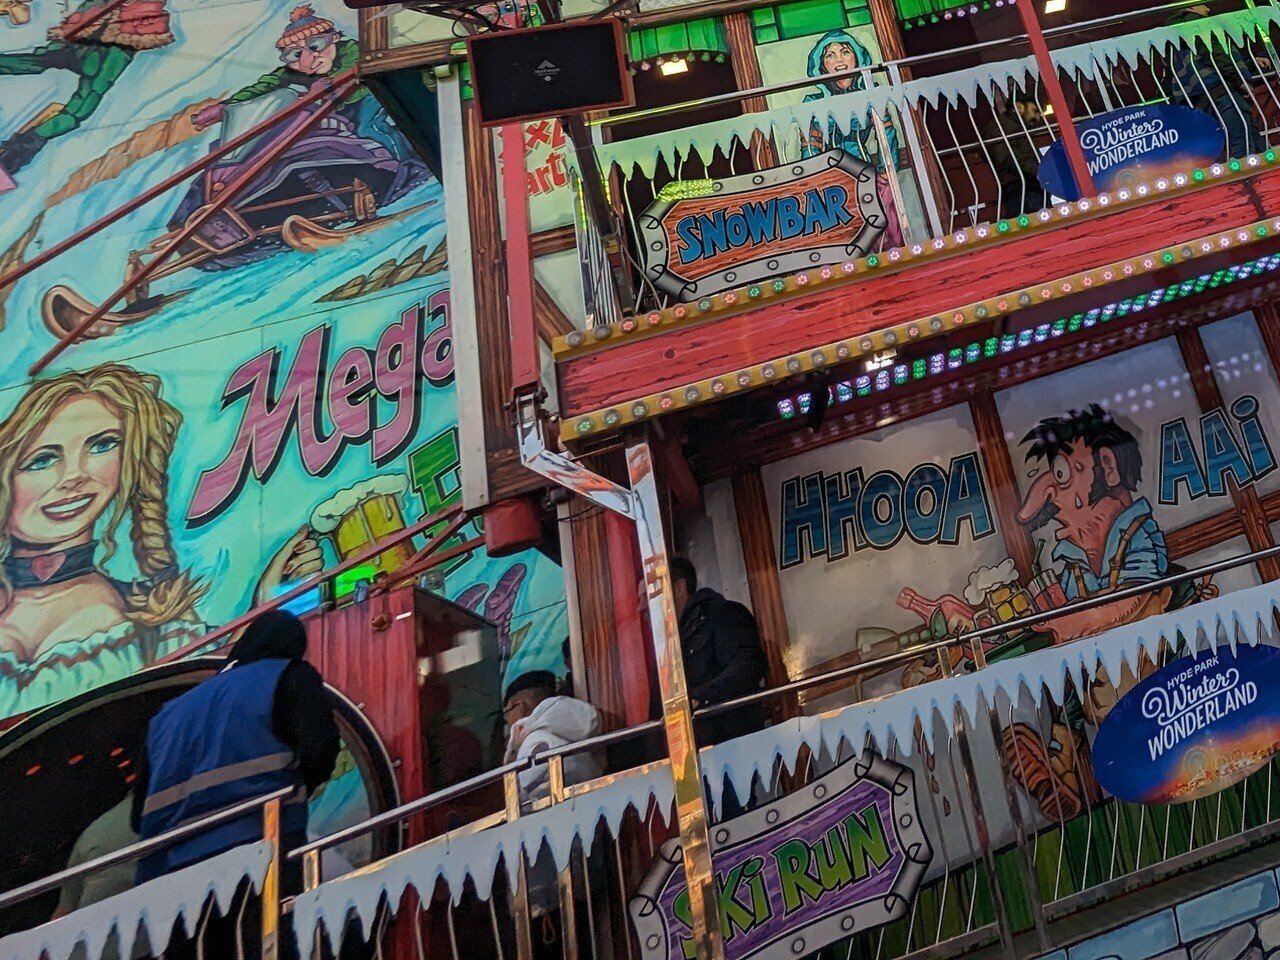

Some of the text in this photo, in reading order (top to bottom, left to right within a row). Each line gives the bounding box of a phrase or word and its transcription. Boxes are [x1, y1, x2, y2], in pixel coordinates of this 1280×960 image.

[1080, 119, 1164, 155] Winter
[1101, 110, 1147, 131] HYDE PARK
[1086, 128, 1179, 177] WONDERLAND
[778, 451, 997, 570] HHOOA
[1142, 667, 1240, 726] Winter
[1167, 655, 1220, 690] HYDE PARK
[1148, 681, 1258, 762] WONDERLAND
